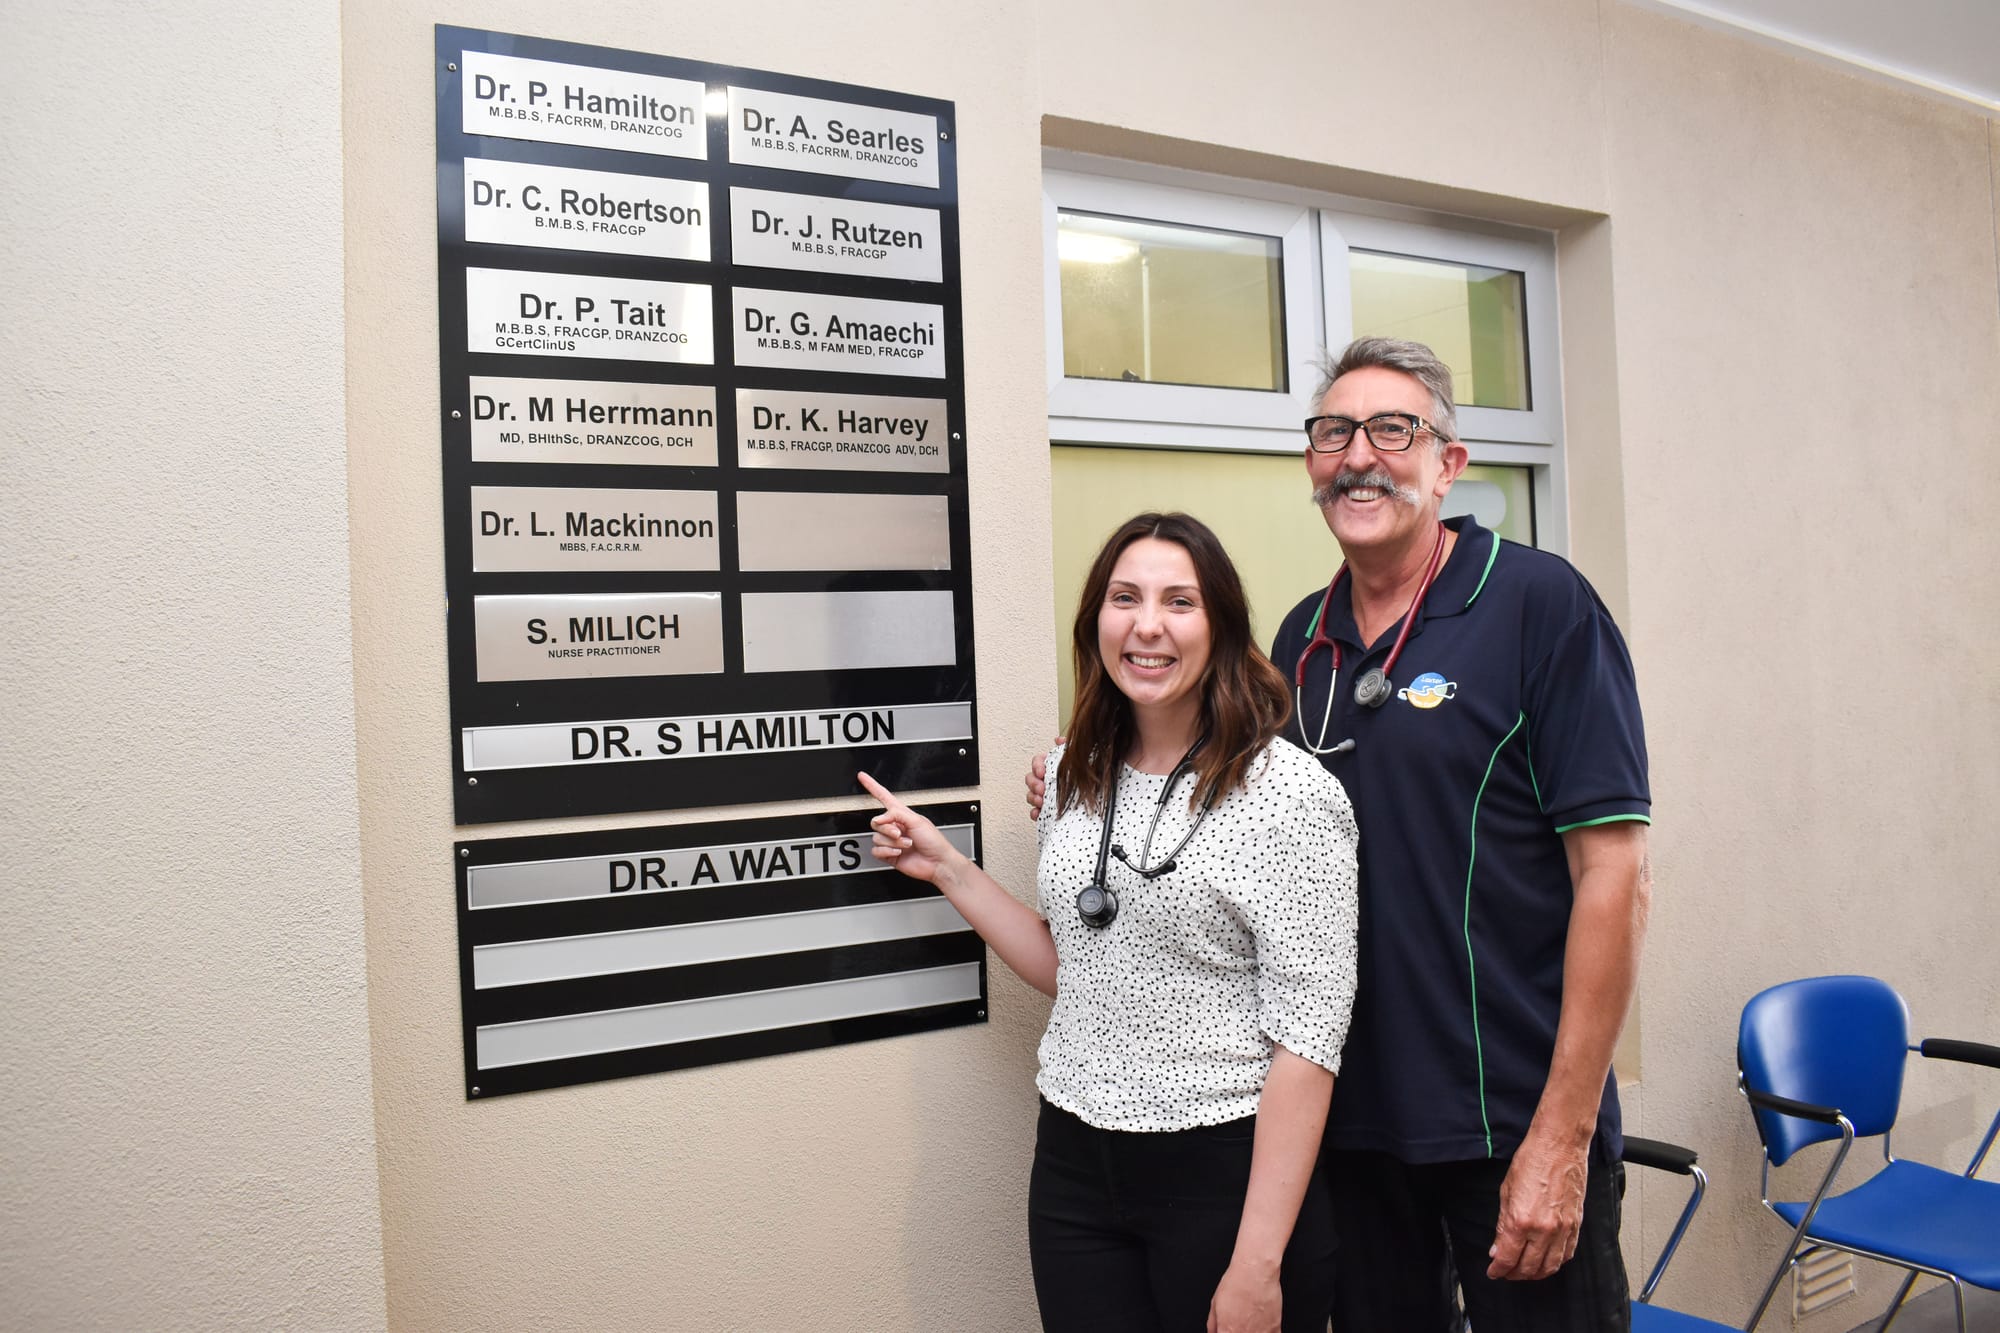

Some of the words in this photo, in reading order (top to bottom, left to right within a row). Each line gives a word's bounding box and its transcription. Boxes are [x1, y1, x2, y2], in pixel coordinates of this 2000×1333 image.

[475, 74, 516, 103] Dr.
[529, 81, 552, 107] P.
[564, 85, 694, 126] Hamilton
[489, 106, 543, 125] M.B.B.S,
[548, 113, 606, 130] FACRRM,
[610, 119, 684, 138] DRANZCOG
[743, 108, 780, 135] Dr.
[789, 115, 817, 140] A.
[824, 120, 924, 155] Searles
[751, 137, 798, 153] M.B.B.S,
[802, 142, 853, 160] FACRRM,
[856, 148, 919, 168] DRANZCOG
[473, 180, 511, 208] Dr.
[522, 185, 550, 212] C.
[561, 189, 701, 227] Robertson
[535, 216, 588, 232] B.M.B.S,
[592, 222, 646, 236] FRACGP
[752, 209, 789, 236] Dr.
[799, 215, 821, 239] J.
[832, 218, 922, 250] Rutzen
[792, 241, 838, 256] M.B.B.S,
[841, 246, 887, 260] FRACGP
[520, 293, 562, 320] Dr.
[576, 297, 599, 323] P.
[610, 299, 666, 327] Tait
[496, 322, 550, 337] M.B.B.S,
[554, 326, 611, 340] FRACGP,
[615, 329, 688, 343] DRANZCOG
[745, 308, 780, 334] Dr.
[790, 312, 817, 336] G.
[825, 315, 934, 346] Amaechi
[496, 336, 575, 351] GCertClinUS
[758, 337, 805, 352] M.B.B.S,
[808, 341, 818, 351] M
[821, 342, 844, 353] FAM
[848, 344, 875, 357] MED,
[878, 346, 924, 359] FRACGP
[474, 395, 516, 421] Dr.
[529, 397, 553, 422] M
[566, 398, 713, 427] Herrmann
[753, 406, 791, 431] Dr.
[801, 408, 830, 432] K.
[838, 410, 929, 442] Harvey
[500, 432, 524, 444] MD,
[587, 434, 663, 448] DRANZCOG,
[667, 437, 693, 447] DCH
[747, 439, 788, 452] M.B.B.S,
[791, 440, 833, 453] FRACGP,
[836, 442, 891, 454] DRANZCOG
[895, 445, 919, 456] ADV,
[919, 445, 939, 456] DCH
[481, 511, 519, 536] Dr.
[531, 512, 555, 536] L.
[566, 512, 713, 538] Mackinnon
[560, 543, 589, 552] MBBS,
[591, 543, 642, 552] F.A.C.R.R.M.
[527, 618, 557, 644] S.
[569, 614, 679, 643] MILICH
[548, 648, 584, 658] NURSE
[586, 645, 661, 657] PRACTITIONER
[571, 725, 642, 760] DR.
[657, 722, 682, 755] S
[697, 710, 896, 753] HAMILTON
[609, 857, 678, 893] DR.
[690, 853, 720, 886] A
[729, 839, 862, 882] WATTS
